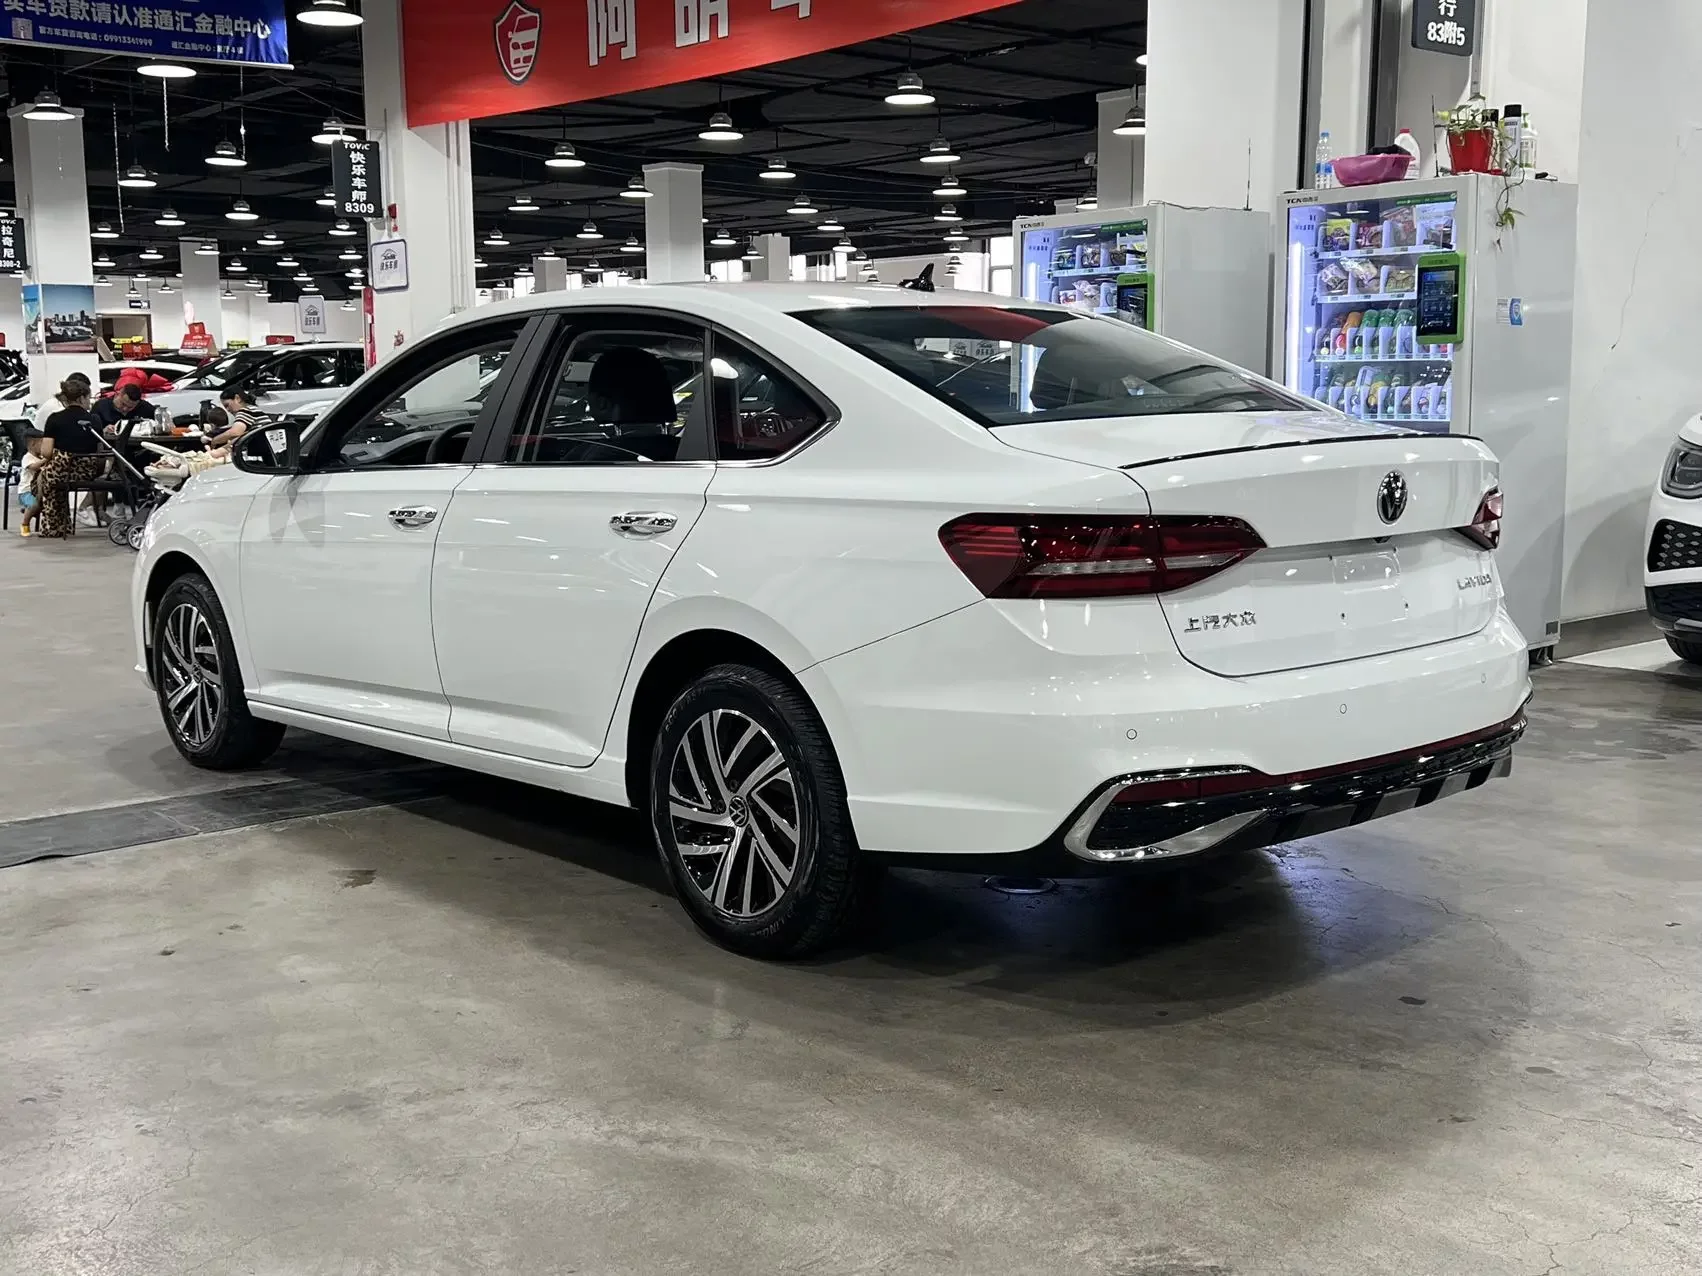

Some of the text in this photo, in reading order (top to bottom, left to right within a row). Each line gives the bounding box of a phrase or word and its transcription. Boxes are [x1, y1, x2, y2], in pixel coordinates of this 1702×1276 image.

[349, 151, 368, 202] 快乐车师
[344, 202, 375, 214] 8309
